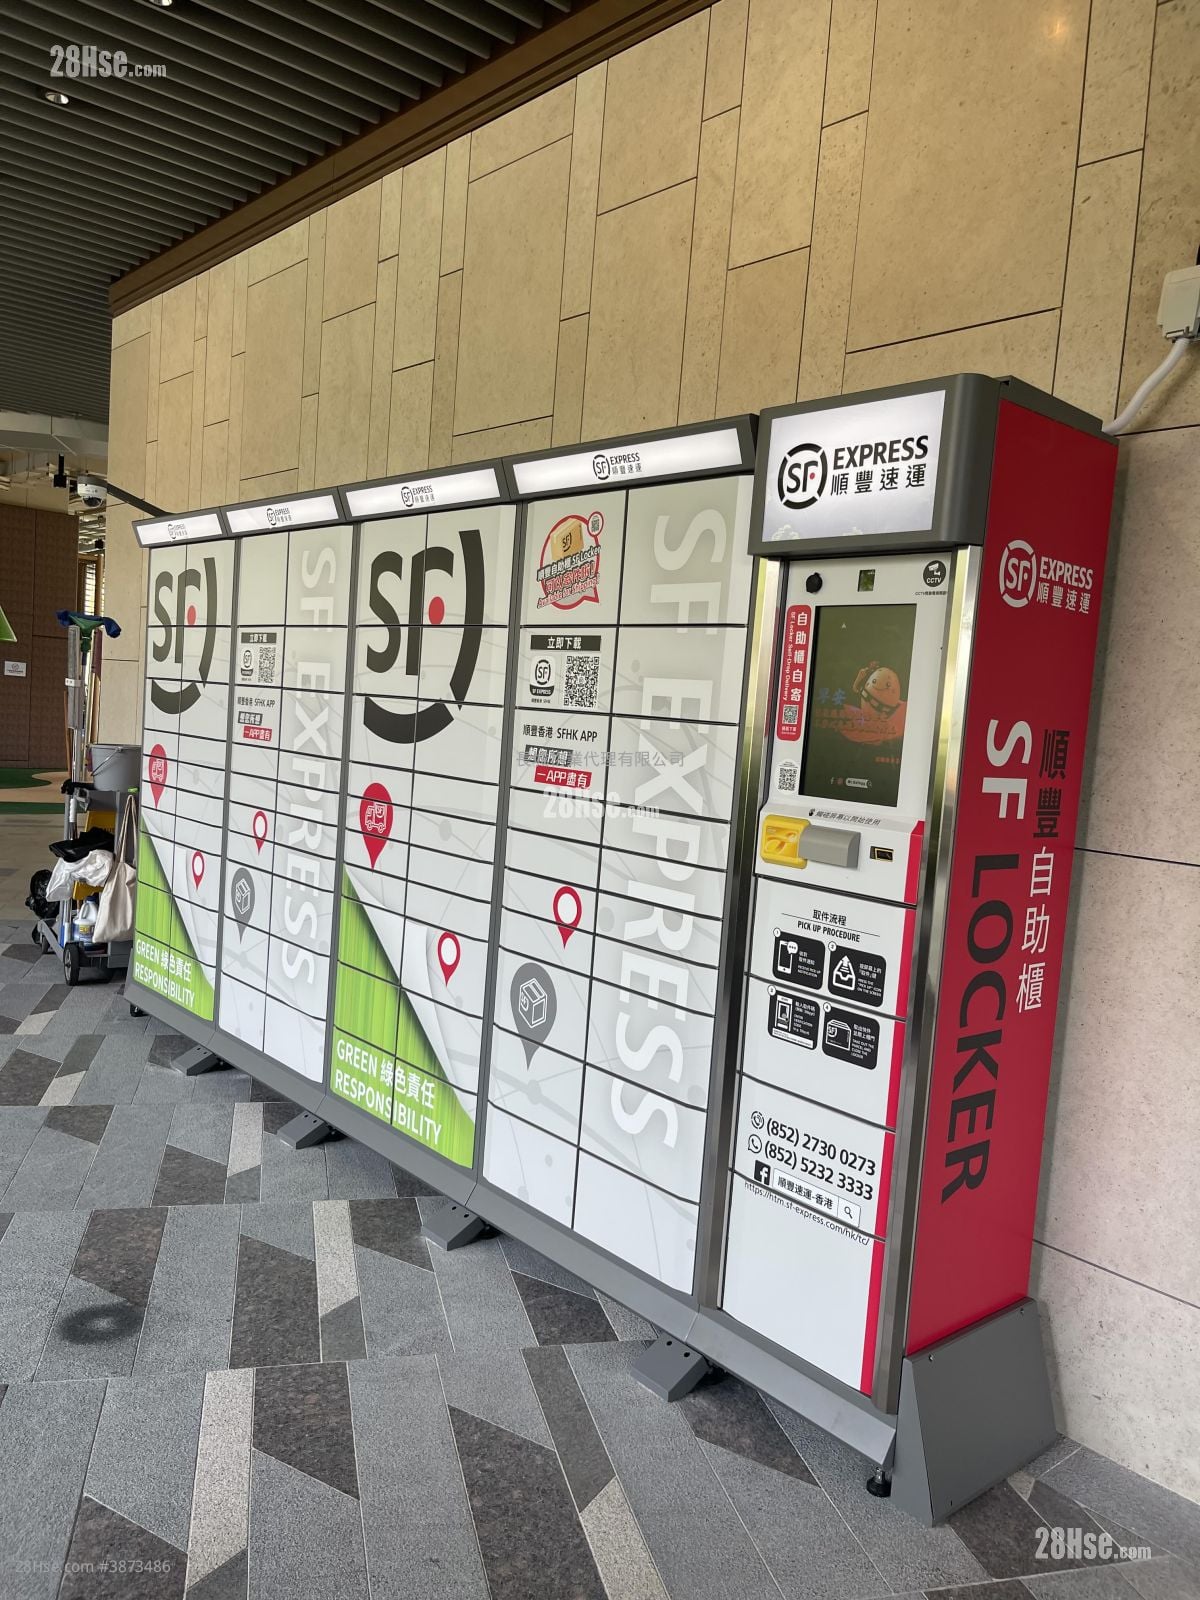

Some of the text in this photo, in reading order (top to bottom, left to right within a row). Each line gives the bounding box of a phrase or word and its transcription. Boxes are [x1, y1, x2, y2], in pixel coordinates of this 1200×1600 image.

[610, 453, 641, 466] EXPRESS
[833, 435, 929, 470] EXPRESS
[412, 485, 434, 495] EXPRESS
[831, 463, 926, 497] 順豐速運
[580, 545, 602, 560] Locker
[301, 546, 337, 632] SF
[650, 509, 725, 637] SF
[1039, 556, 1094, 591] EXPRESS
[1037, 581, 1091, 614] 順豐速運
[547, 636, 582, 650] 立即下載
[790, 611, 808, 702] 自助櫃自寄
[266, 699, 275, 708] APP
[783, 675, 791, 701] Delivery
[523, 724, 598, 742] 順豐香港 SFHK APP
[537, 766, 590, 788] 一APP盡有
[982, 719, 1033, 820] SF
[281, 661, 331, 985] EXPRESS
[1016, 728, 1070, 1014] 順豐自助櫃
[611, 677, 714, 1150] EXPRESS
[813, 909, 847, 926] 取件流程
[797, 920, 861, 943] PICK UP PROCEDURE
[136, 939, 192, 982] GREEN 綠色責任
[135, 961, 195, 1008] RESPONSIBILITY
[941, 854, 1020, 1205] LOCKER
[337, 1039, 435, 1109] GREEN 綠色責任
[335, 1069, 442, 1145] RESPONSIBILITY
[766, 1117, 876, 1177] (852) 2730 0273
[765, 1140, 873, 1201] (852) 5232 3333
[778, 1176, 833, 1210] 順豐速運-香港
